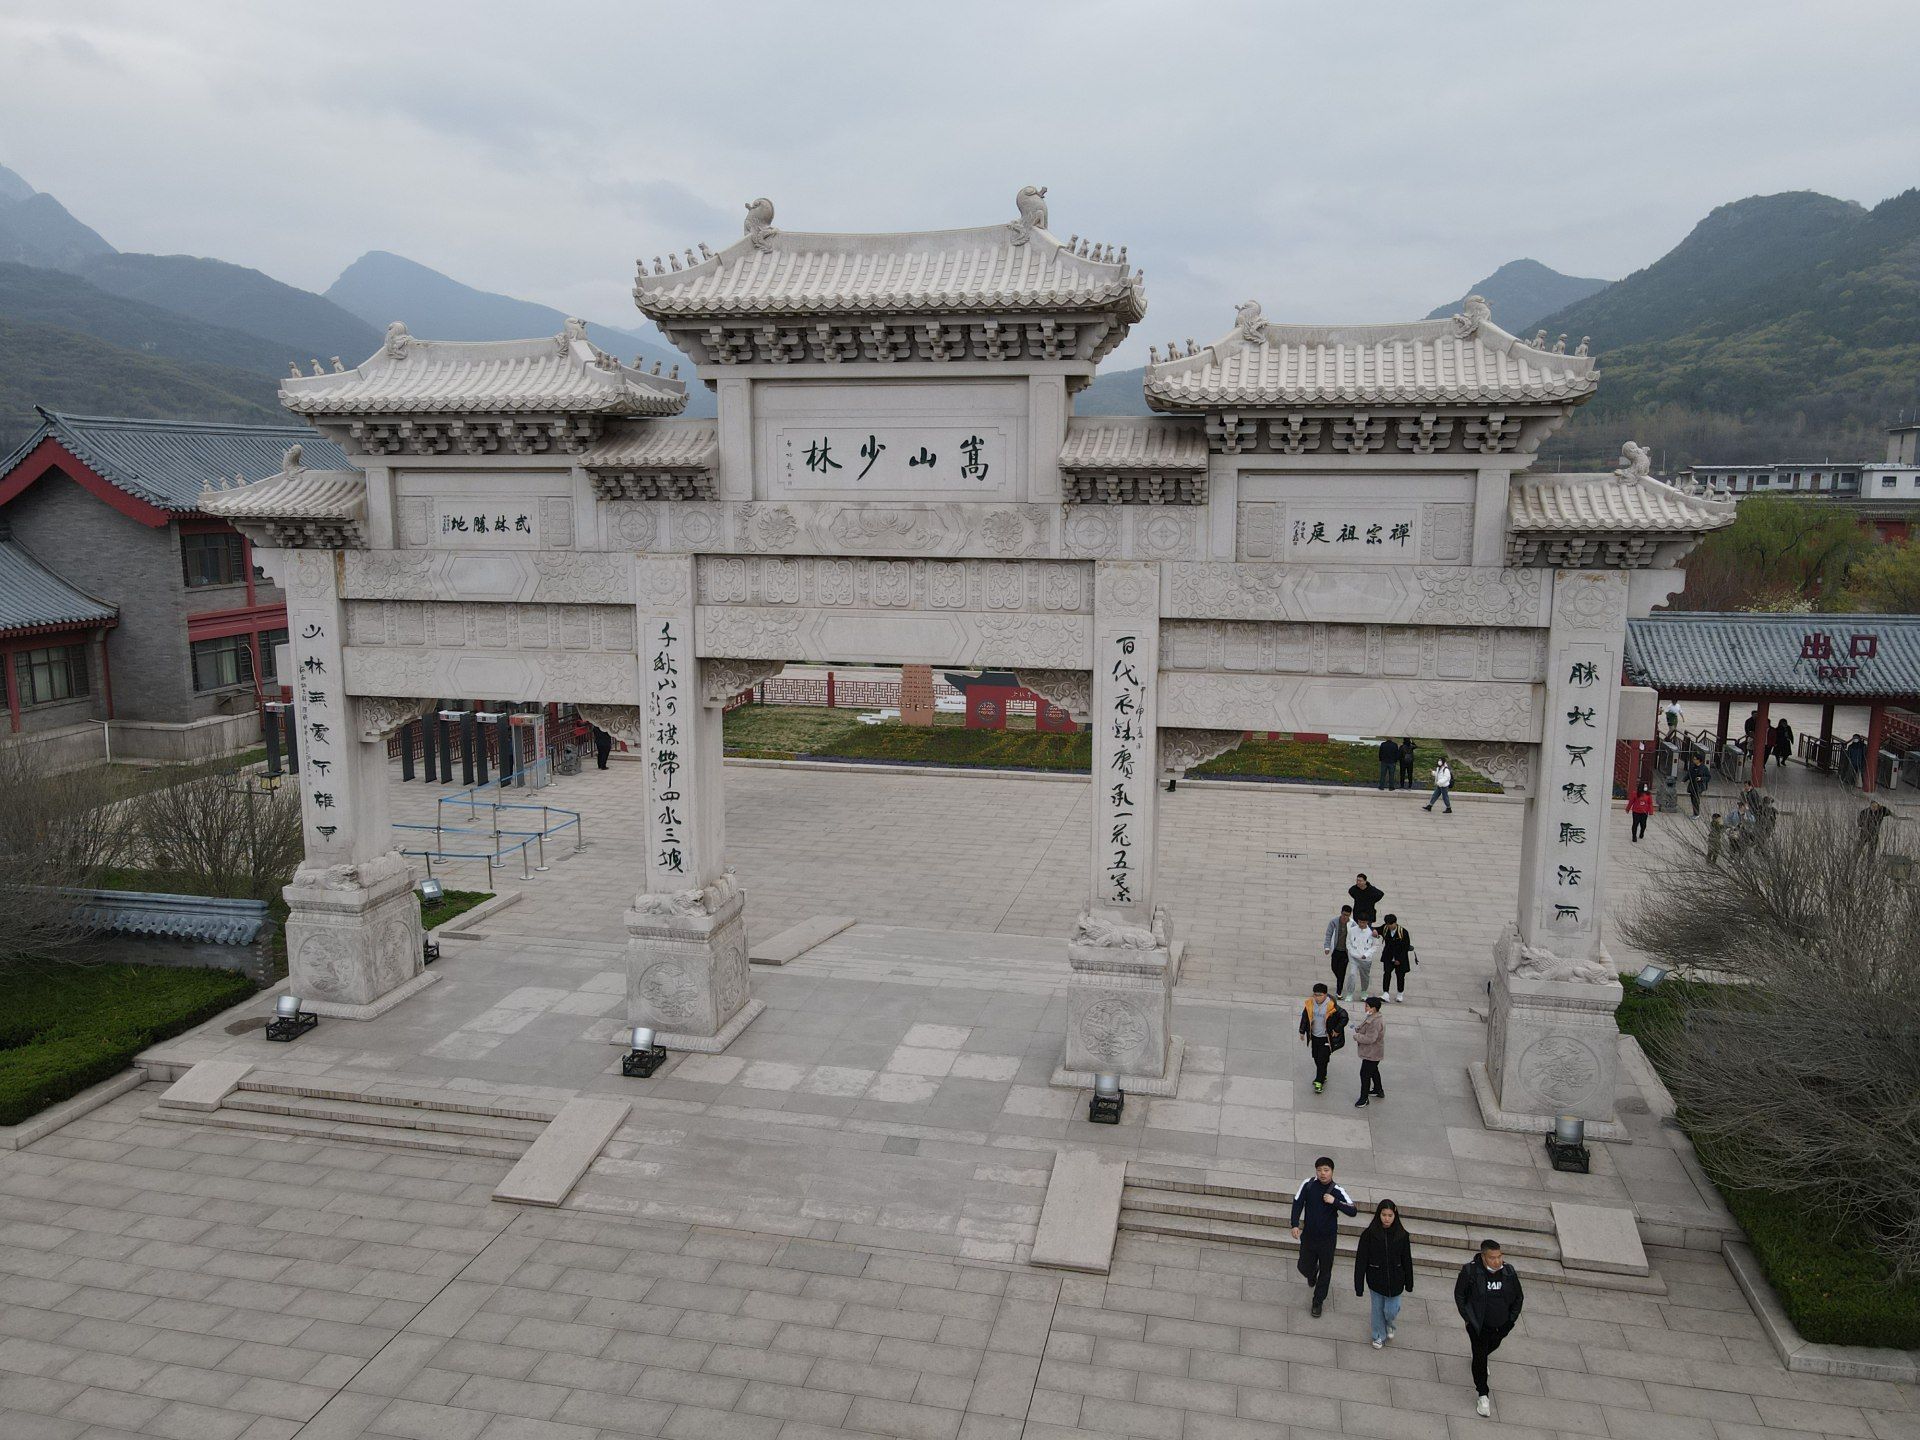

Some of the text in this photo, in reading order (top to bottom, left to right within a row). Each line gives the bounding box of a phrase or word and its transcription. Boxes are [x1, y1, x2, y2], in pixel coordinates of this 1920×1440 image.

[800, 434, 989, 482] 嵩山少林
[1306, 521, 1411, 548] 禪宗祖庭
[1801, 632, 1878, 660] 出口
[1818, 666, 1859, 678] EXIT
